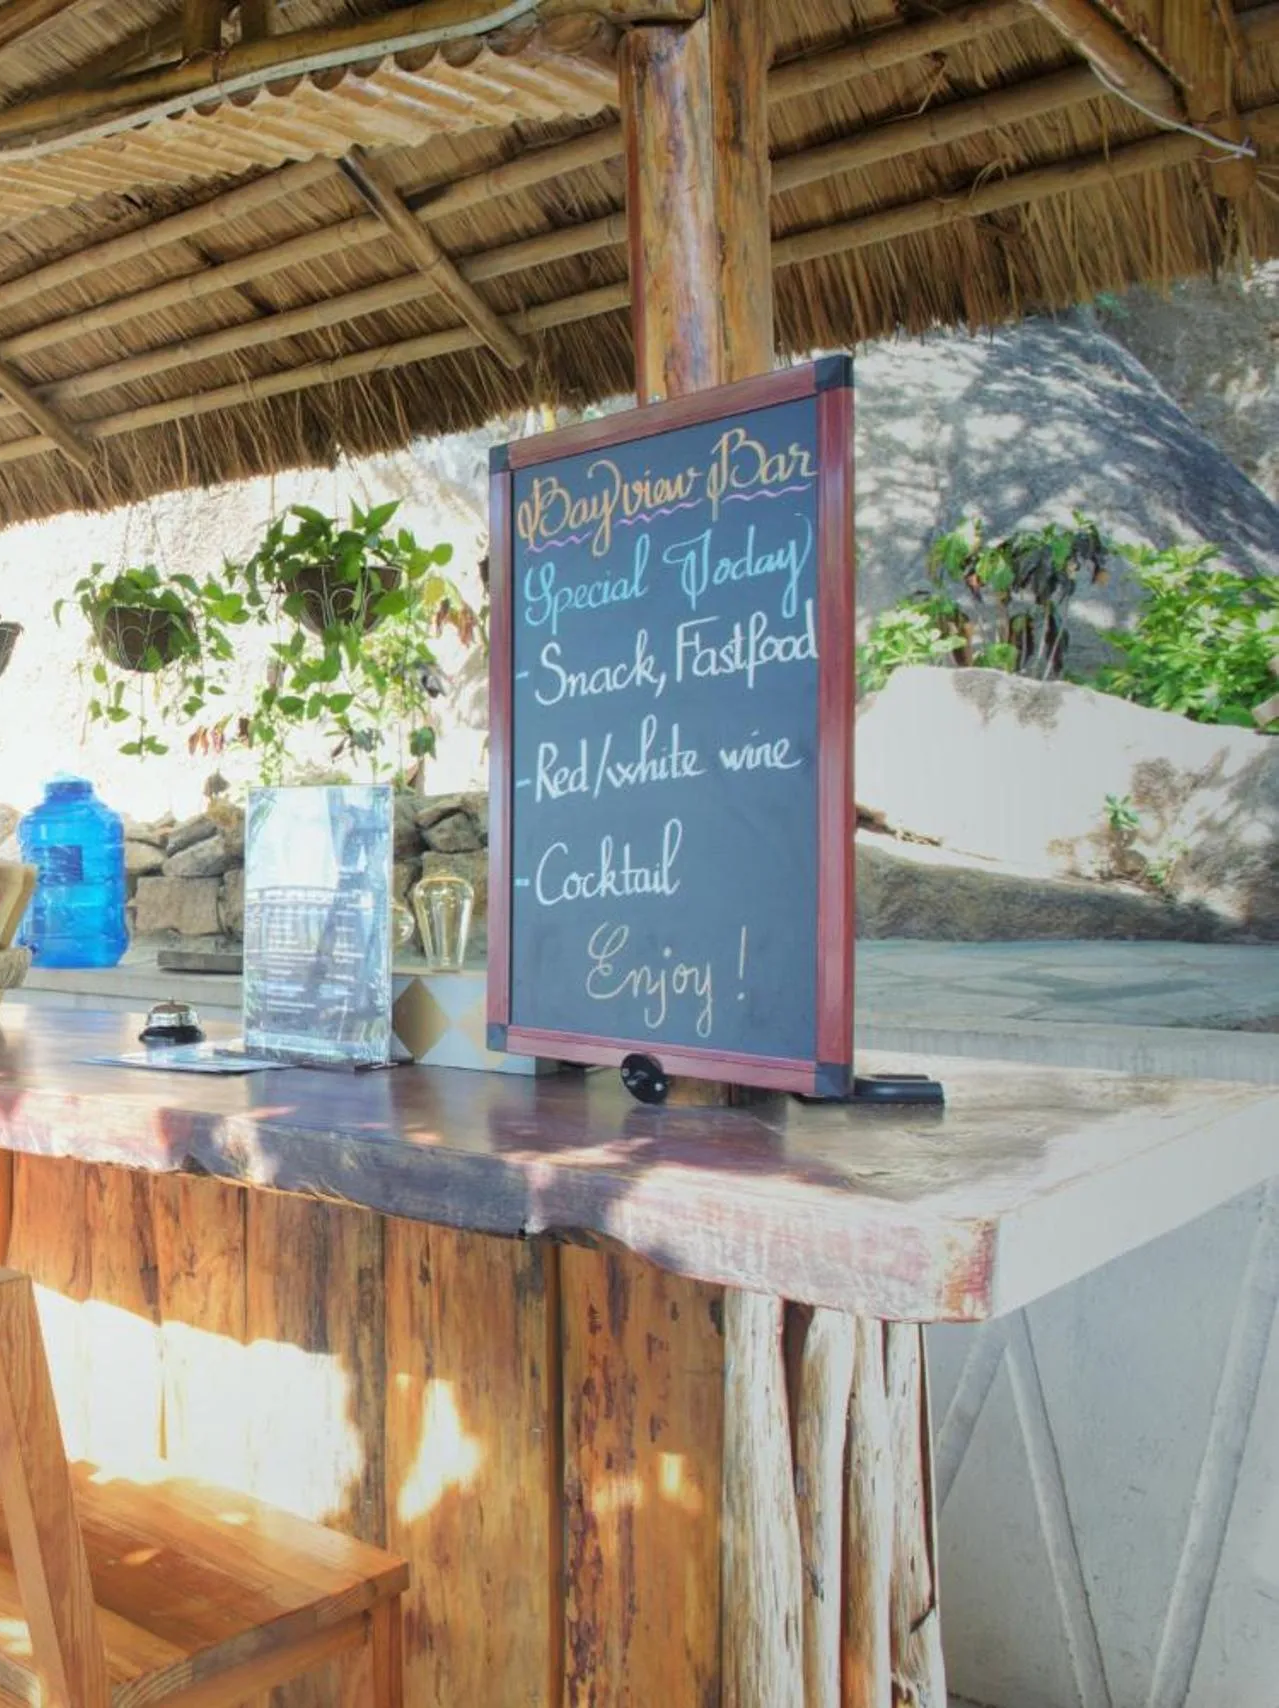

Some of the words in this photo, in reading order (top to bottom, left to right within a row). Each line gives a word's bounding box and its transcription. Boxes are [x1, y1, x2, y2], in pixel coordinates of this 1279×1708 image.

[707, 427, 817, 521] Bar
[524, 533, 650, 635] Special
[663, 513, 812, 618] Today
[676, 598, 819, 689] Fastfood
[720, 732, 803, 771] wine
[586, 922, 713, 1038] Enjoy
